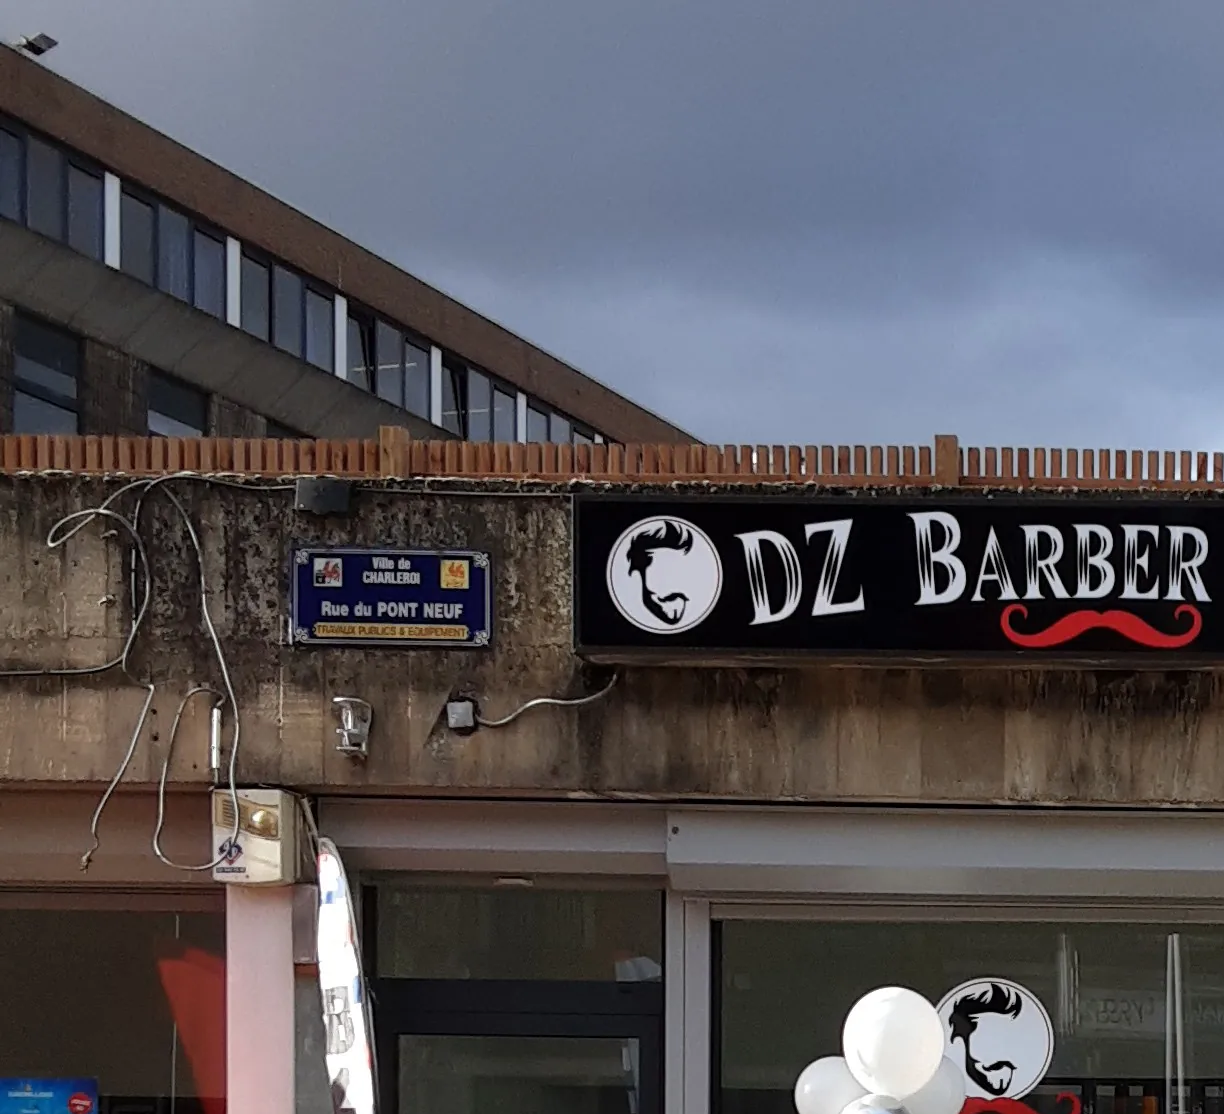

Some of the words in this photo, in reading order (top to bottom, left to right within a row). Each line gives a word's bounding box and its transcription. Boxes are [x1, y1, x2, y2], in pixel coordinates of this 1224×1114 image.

[372, 557, 394, 569] Ville
[398, 558, 411, 569] de
[733, 518, 865, 626] DZ
[906, 511, 1212, 605] BARBER
[363, 571, 421, 585] CHARLEROI
[321, 601, 349, 616] Rue
[354, 602, 372, 617] du
[377, 602, 418, 617] PONT
[424, 603, 464, 619] NEUF
[359, 626, 396, 636] PUBLICS
